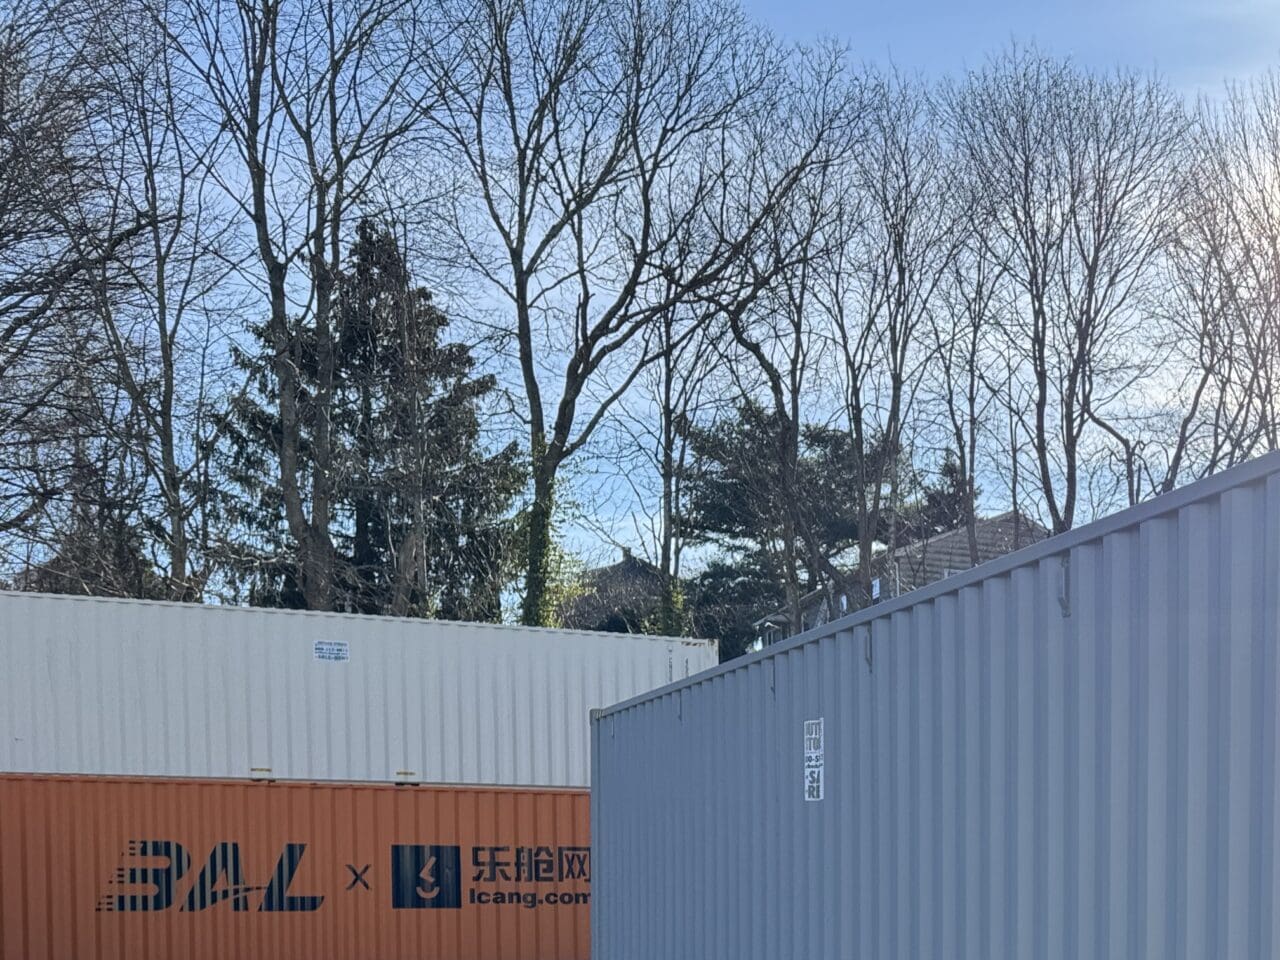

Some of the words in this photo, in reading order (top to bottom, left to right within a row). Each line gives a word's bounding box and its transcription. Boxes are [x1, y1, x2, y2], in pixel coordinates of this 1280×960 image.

[95, 841, 325, 912] BAL
[472, 846, 591, 883] 乐舱网
